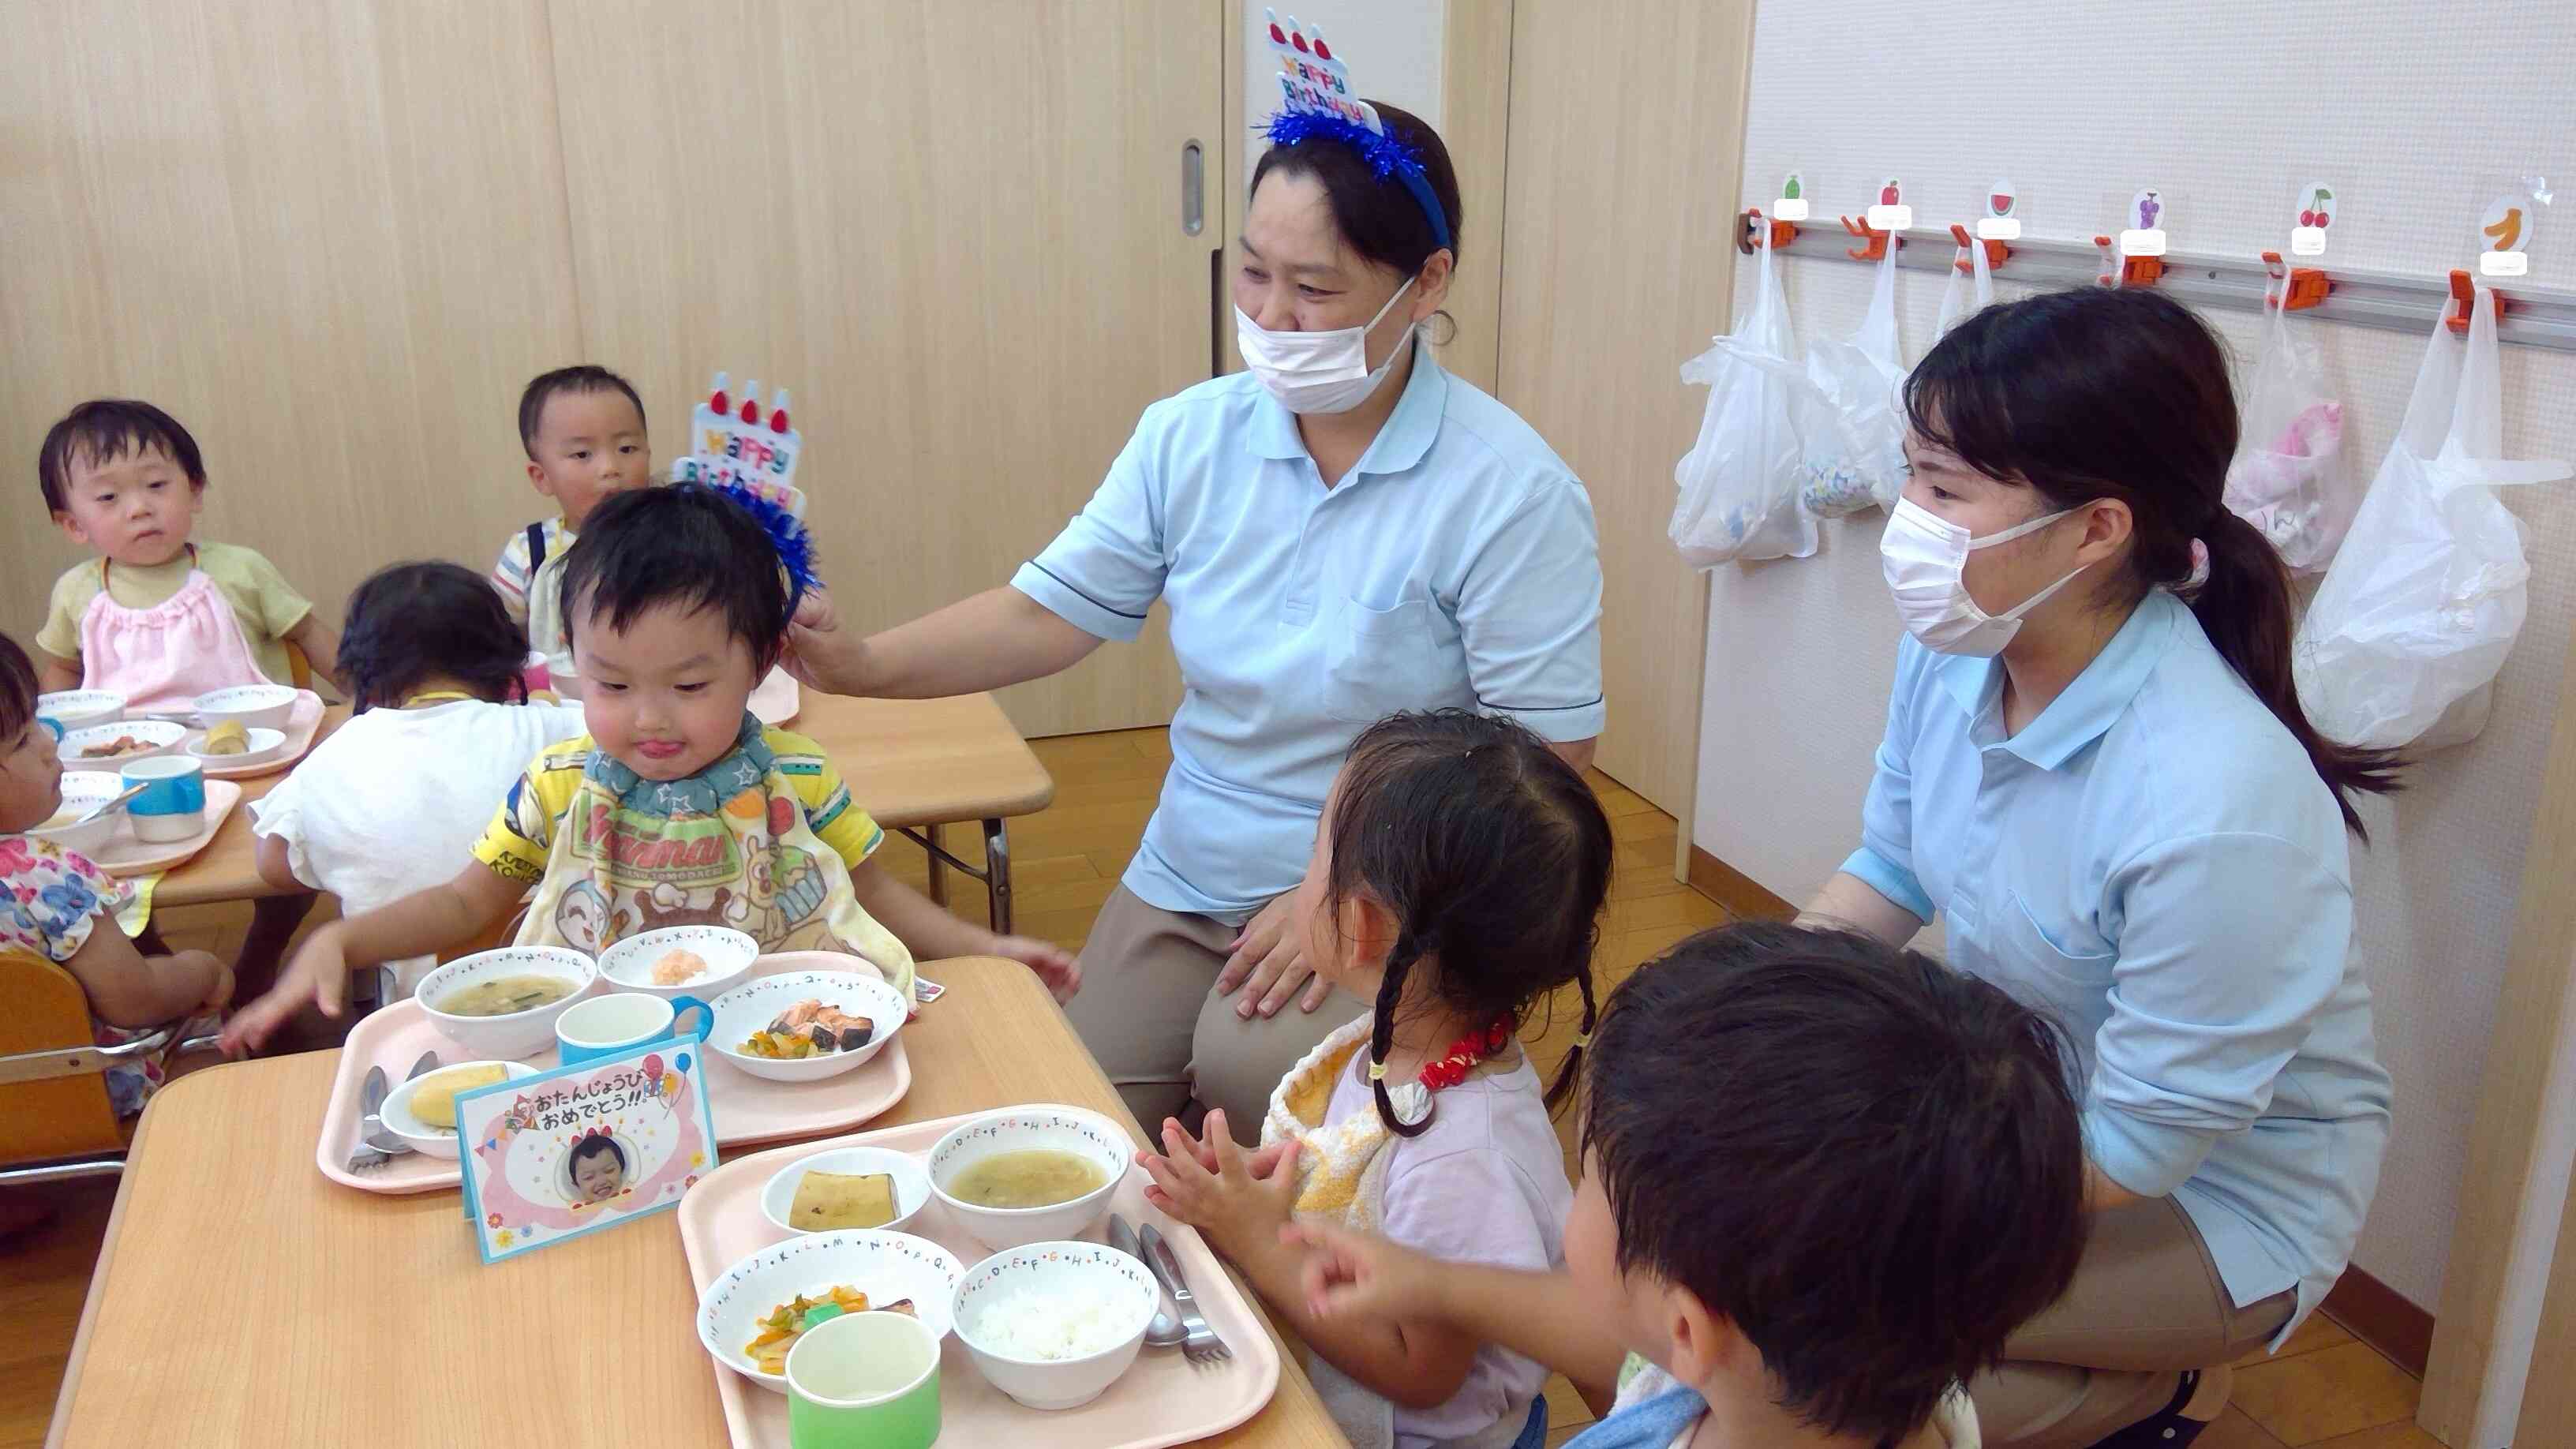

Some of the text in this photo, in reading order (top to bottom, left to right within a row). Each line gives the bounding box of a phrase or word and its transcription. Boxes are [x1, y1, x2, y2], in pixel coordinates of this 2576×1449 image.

[534, 1068, 646, 1113] おたんじょうび
[541, 1089, 643, 1130] おめでとう!!
